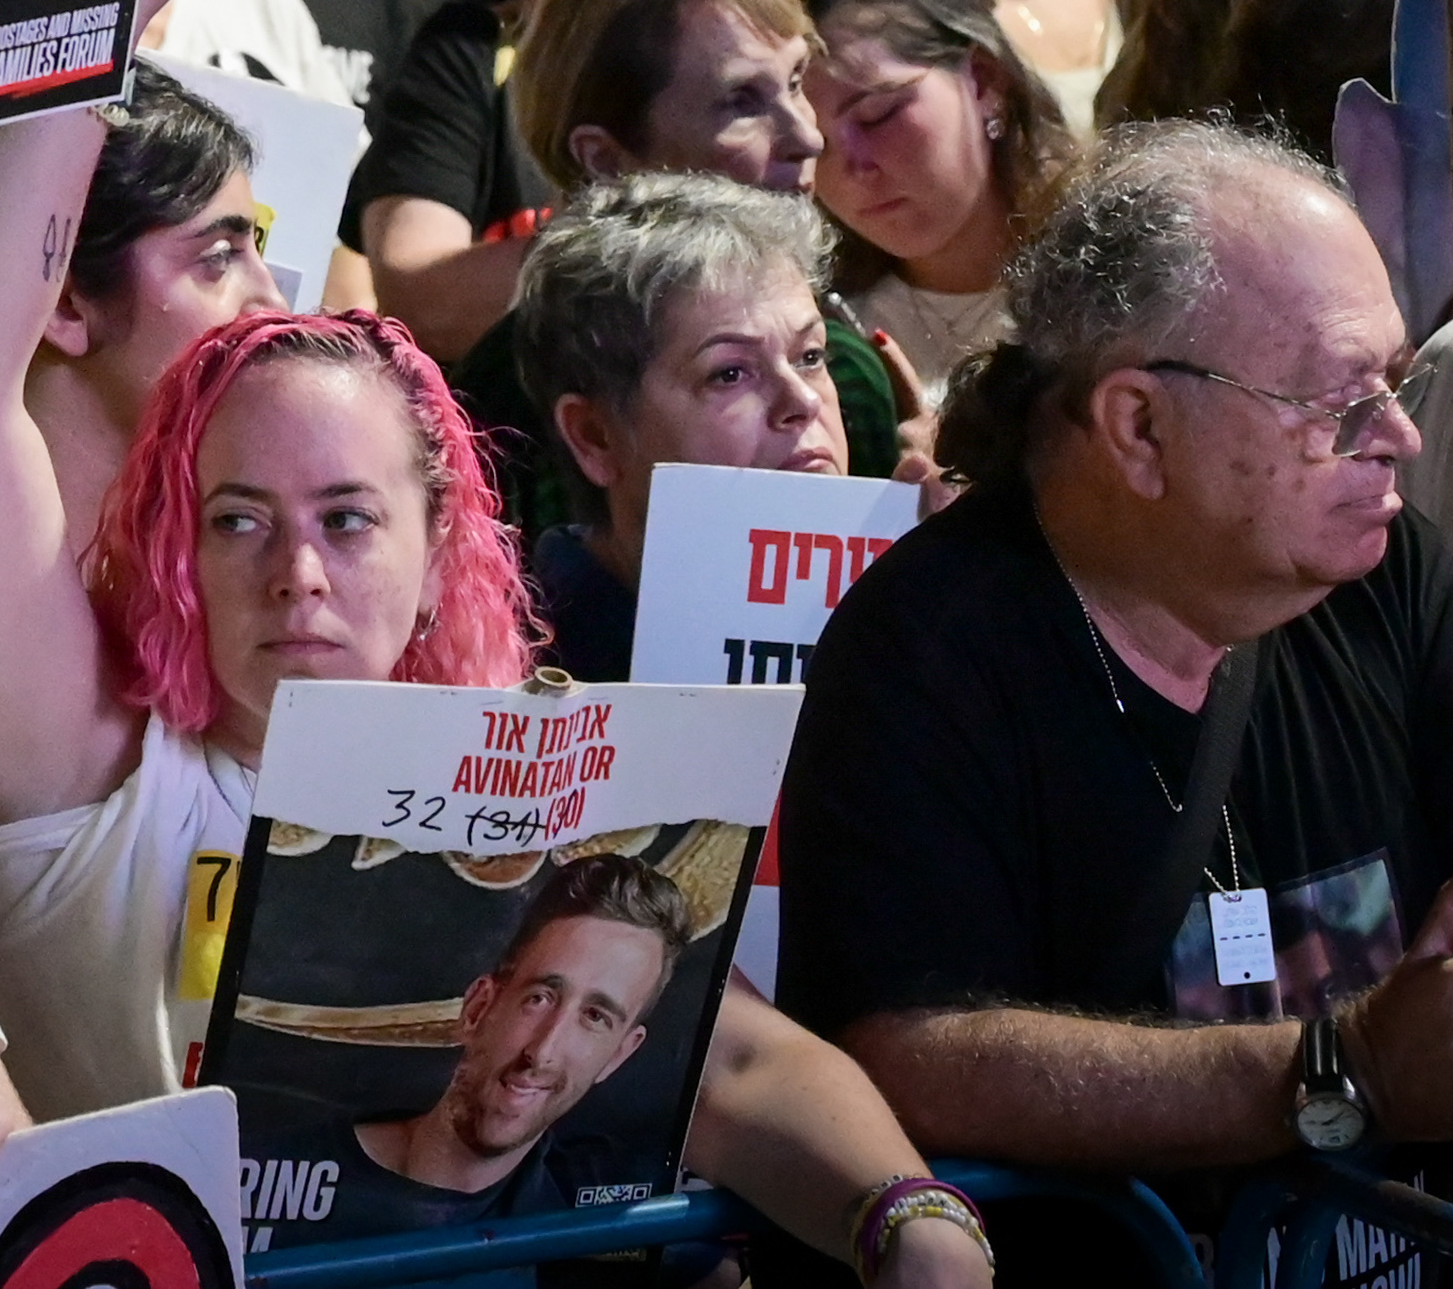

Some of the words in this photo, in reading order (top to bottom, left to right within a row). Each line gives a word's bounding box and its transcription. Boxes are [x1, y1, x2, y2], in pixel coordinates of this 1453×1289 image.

[48, 12, 71, 39] AND
[70, 1, 120, 34] MISSING
[56, 28, 116, 74] FORUM
[483, 711, 529, 753] אור
[536, 704, 612, 759] אבינתן
[452, 751, 577, 799] AVINATAN
[580, 745, 615, 782] OR
[382, 789, 446, 832] 32
[240, 1158, 340, 1221] RING
